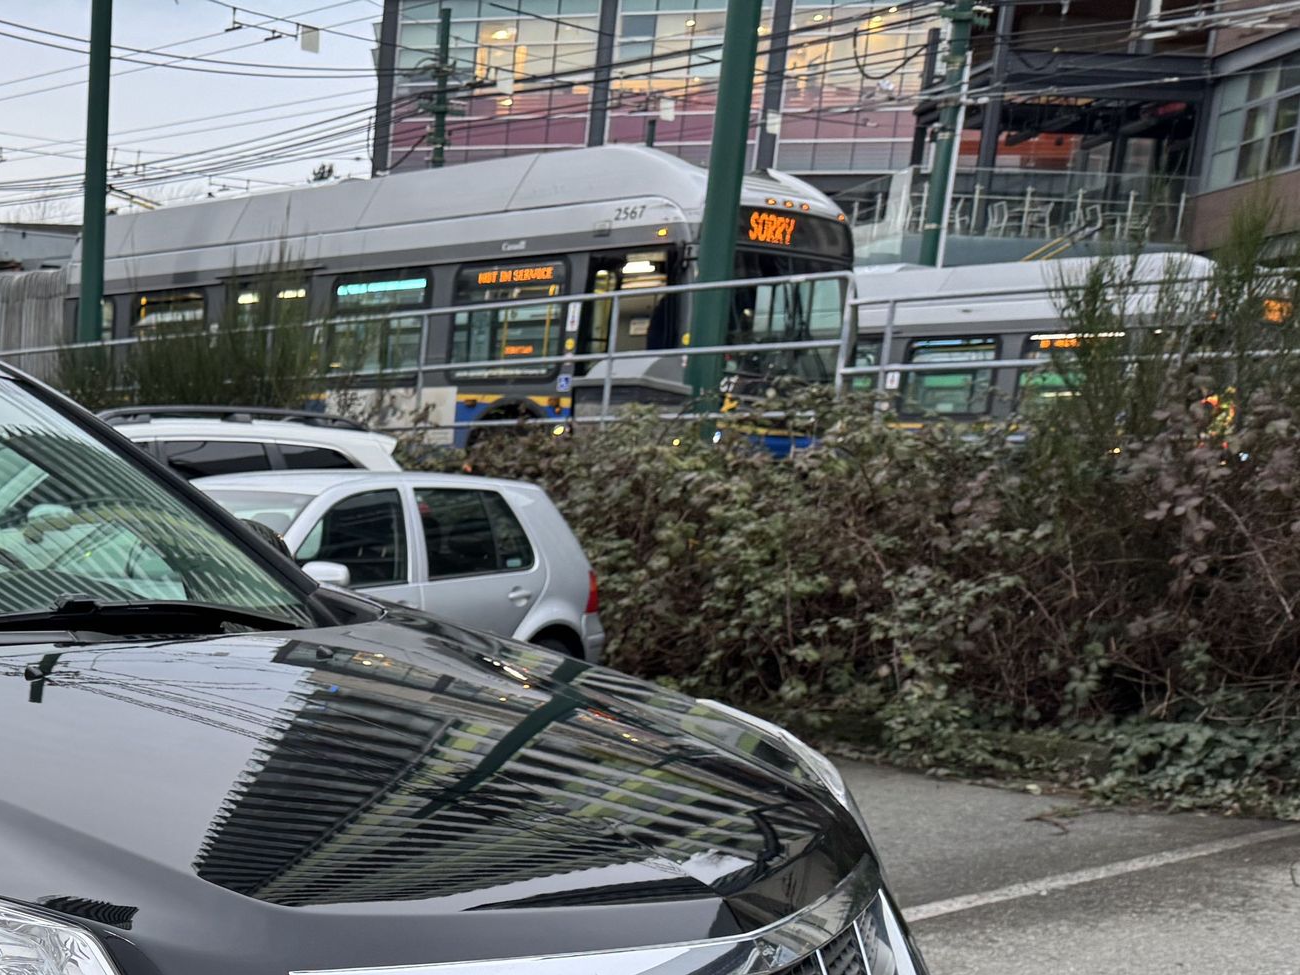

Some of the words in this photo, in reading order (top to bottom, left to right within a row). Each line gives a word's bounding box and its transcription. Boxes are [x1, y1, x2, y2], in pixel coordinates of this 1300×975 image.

[614, 205, 647, 221] 2567
[748, 211, 796, 245] SORRY
[513, 266, 555, 281] SERVICE
